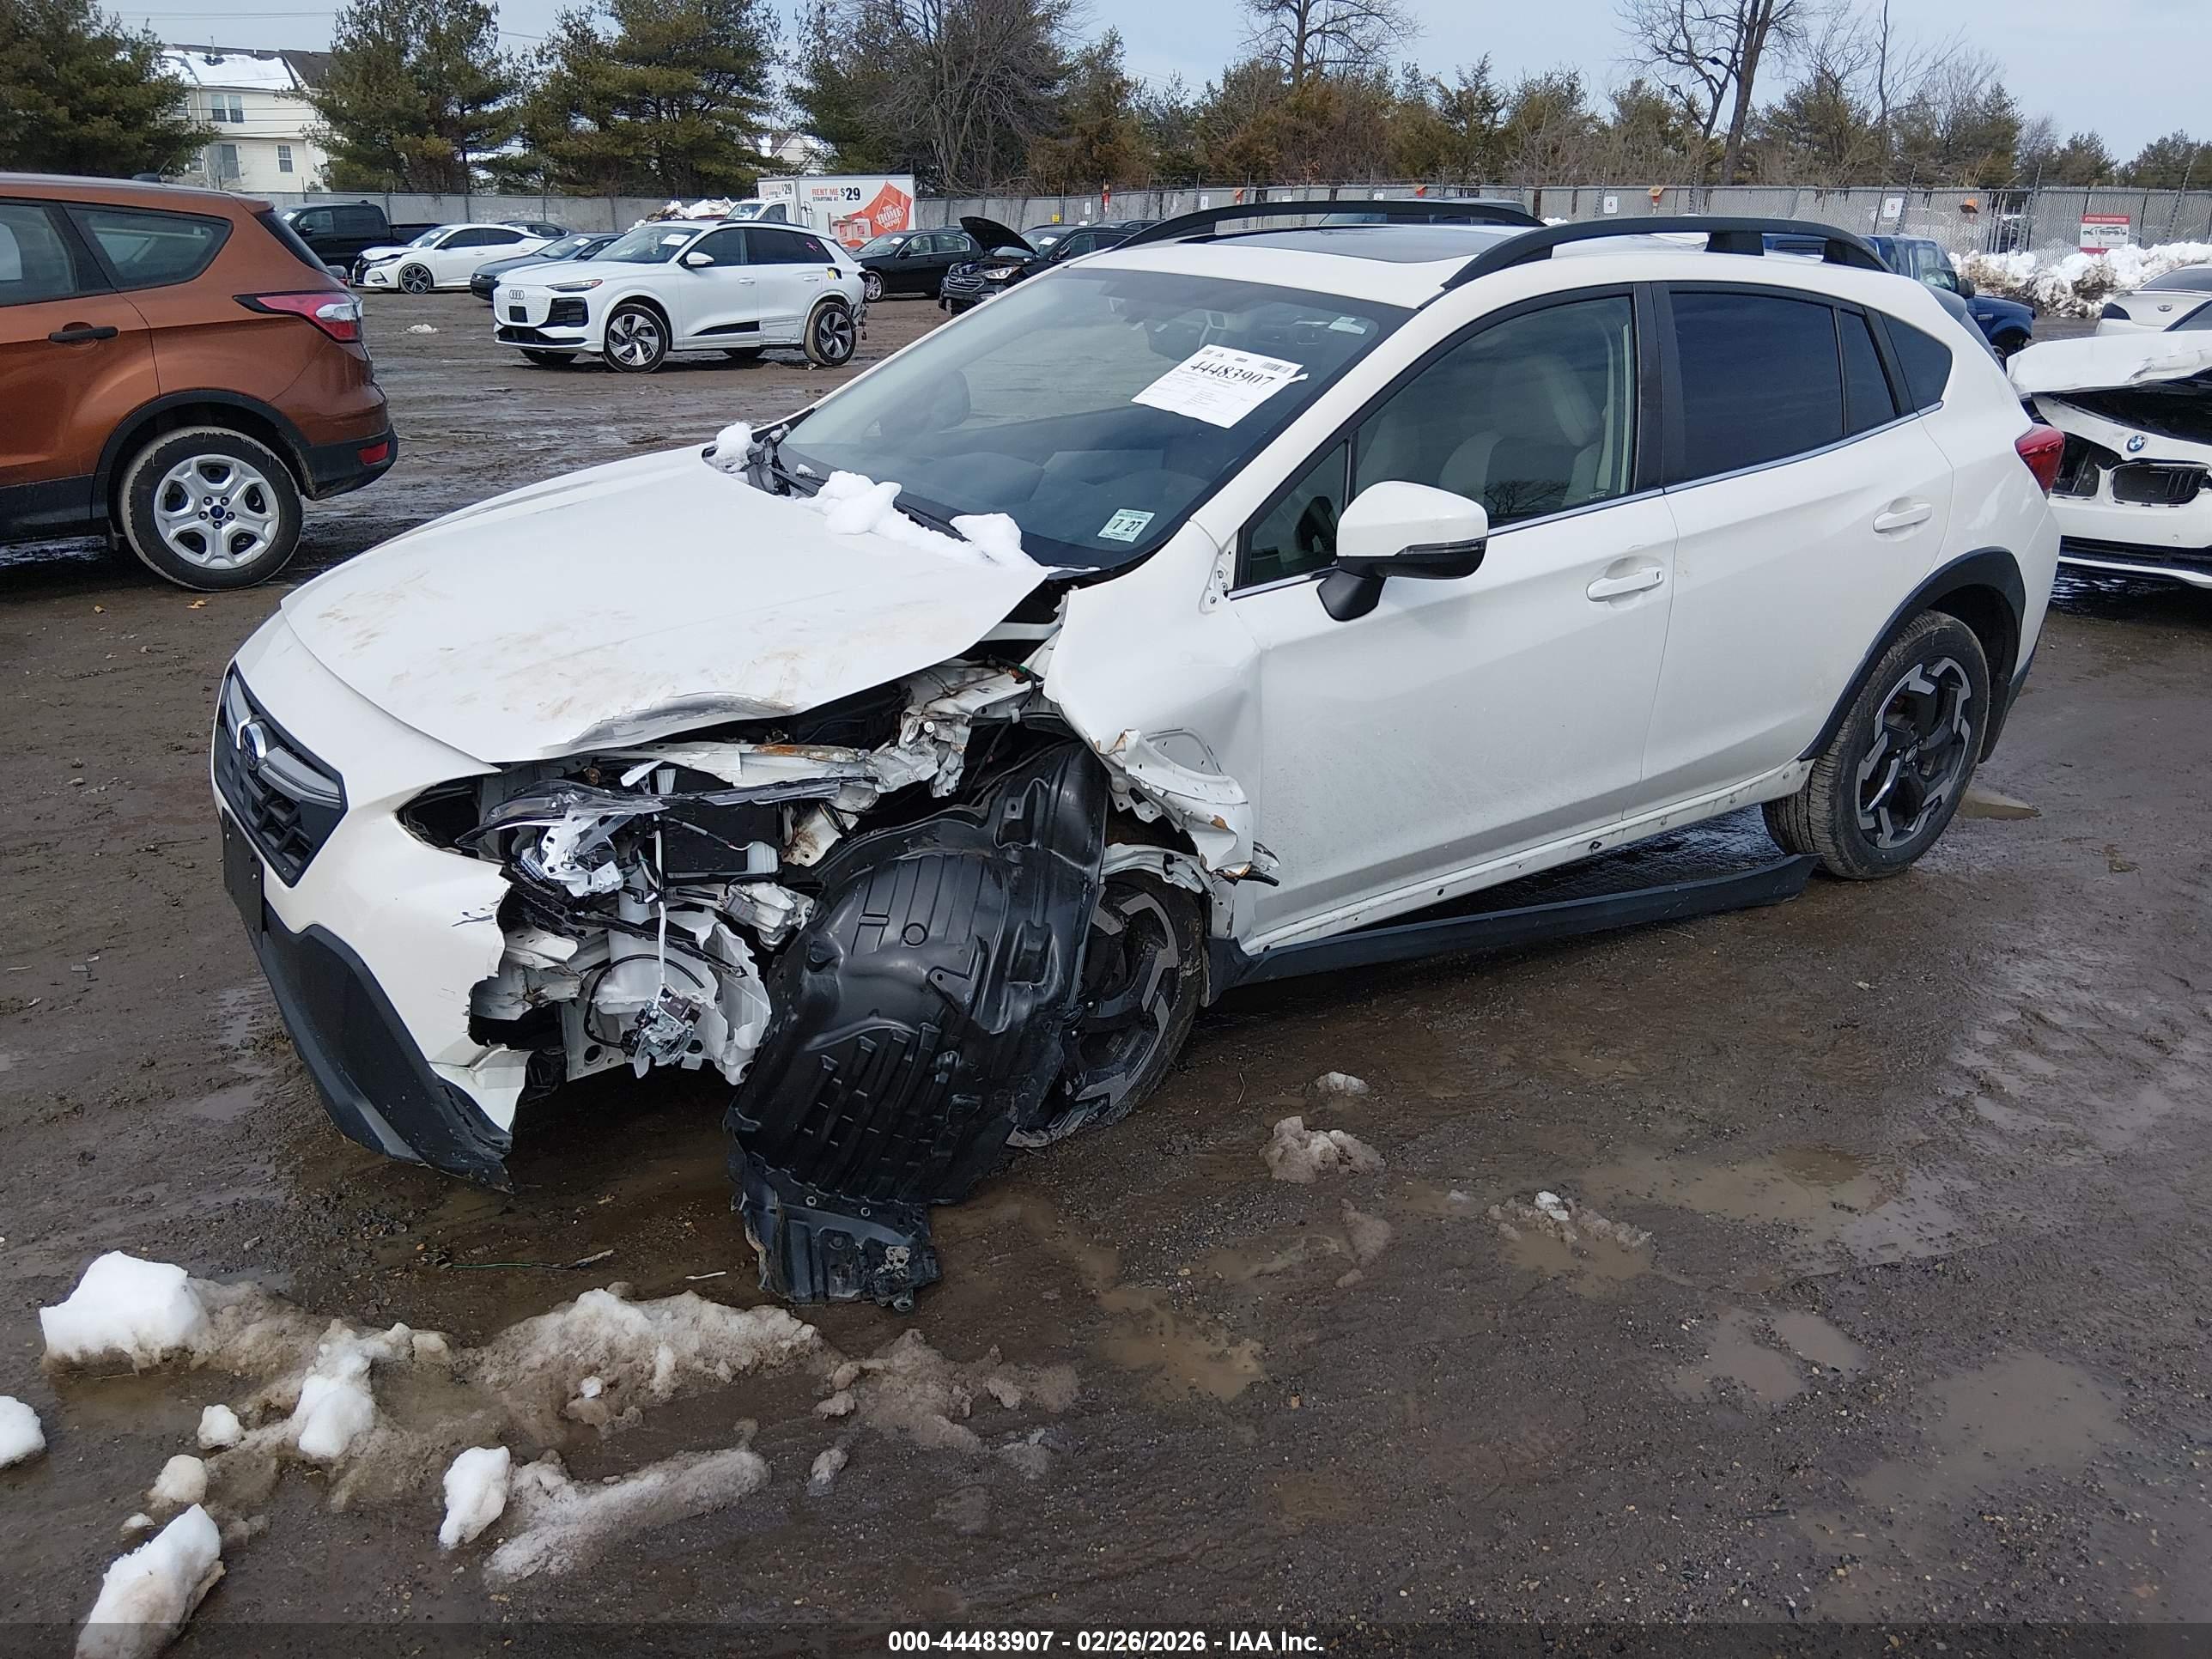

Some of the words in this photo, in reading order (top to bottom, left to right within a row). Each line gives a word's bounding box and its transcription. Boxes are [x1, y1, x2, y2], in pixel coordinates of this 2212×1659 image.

[840, 187, 860, 201] $29
[877, 207, 902, 224] HOME
[1190, 361, 1277, 386] 44483907
[1124, 520, 1143, 532] 27
